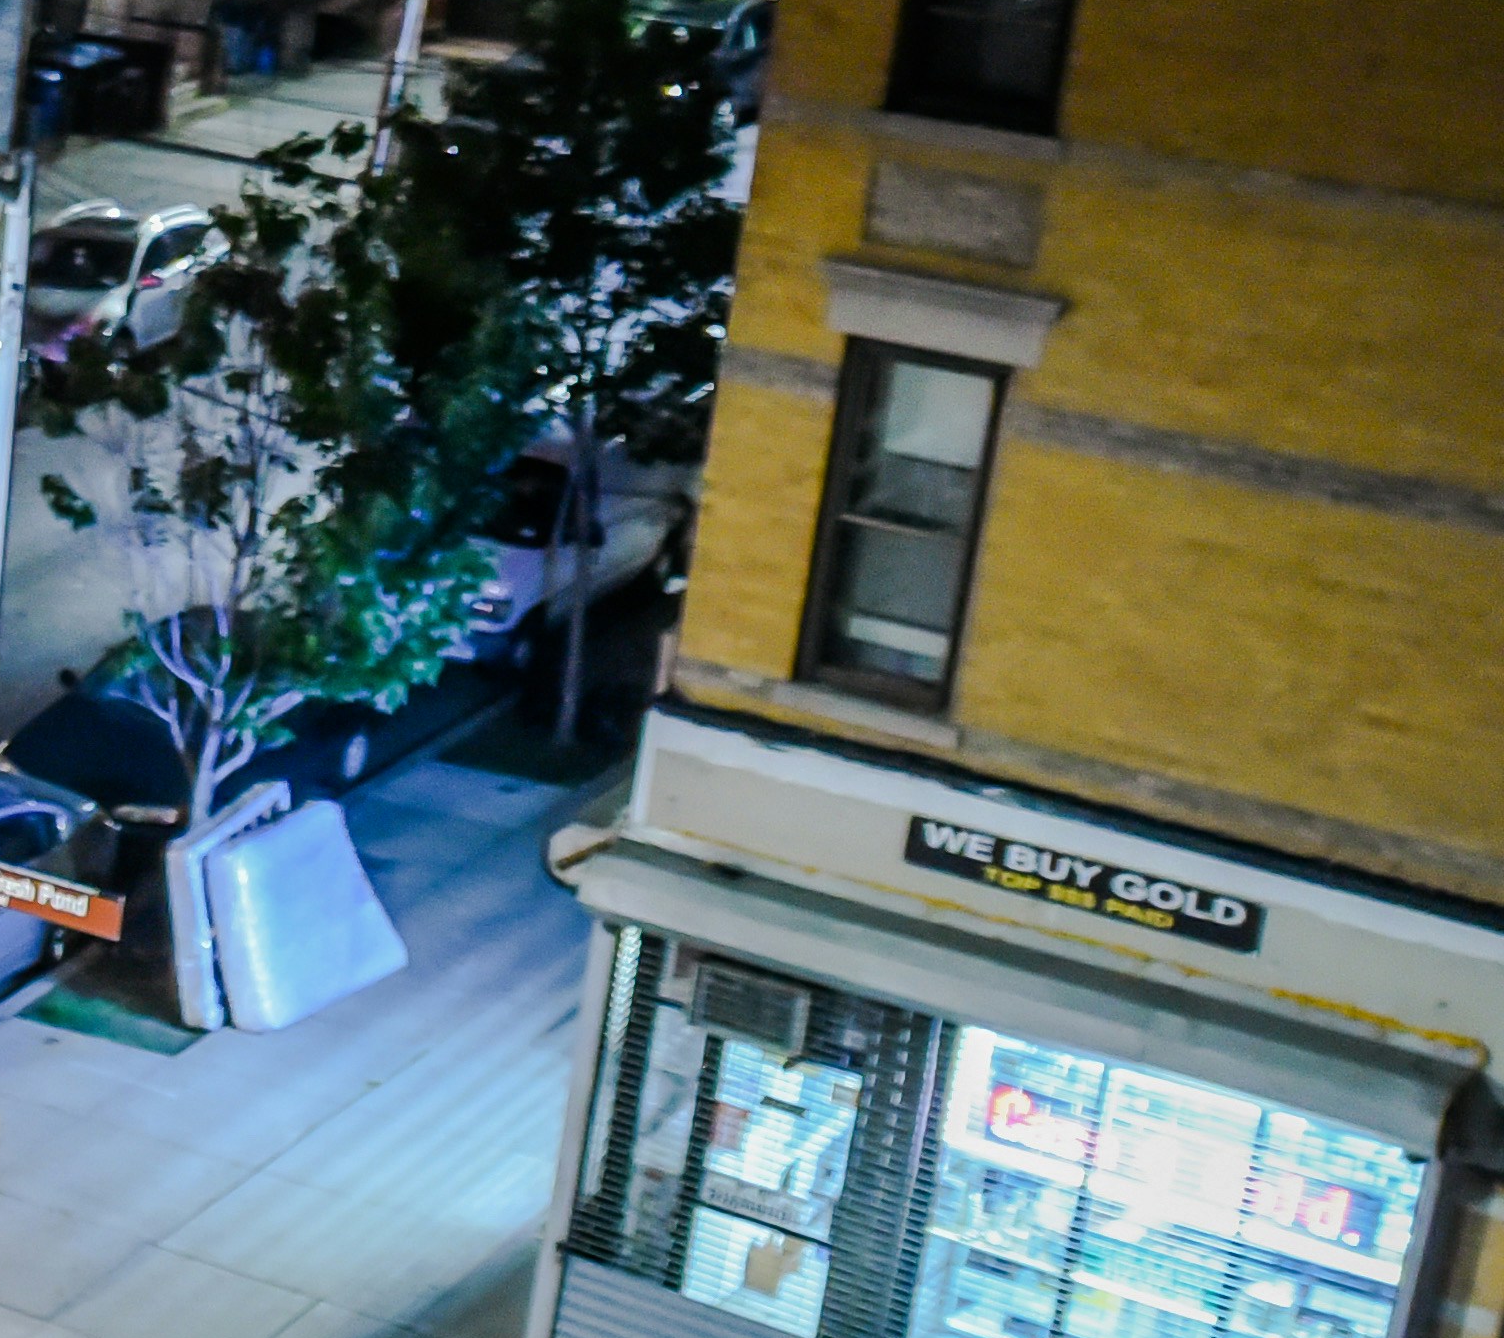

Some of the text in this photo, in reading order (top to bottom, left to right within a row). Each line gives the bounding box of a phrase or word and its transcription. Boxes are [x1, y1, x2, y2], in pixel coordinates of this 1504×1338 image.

[36, 882, 89, 918] Pond
[922, 821, 1248, 928] WE BUY GOLD
